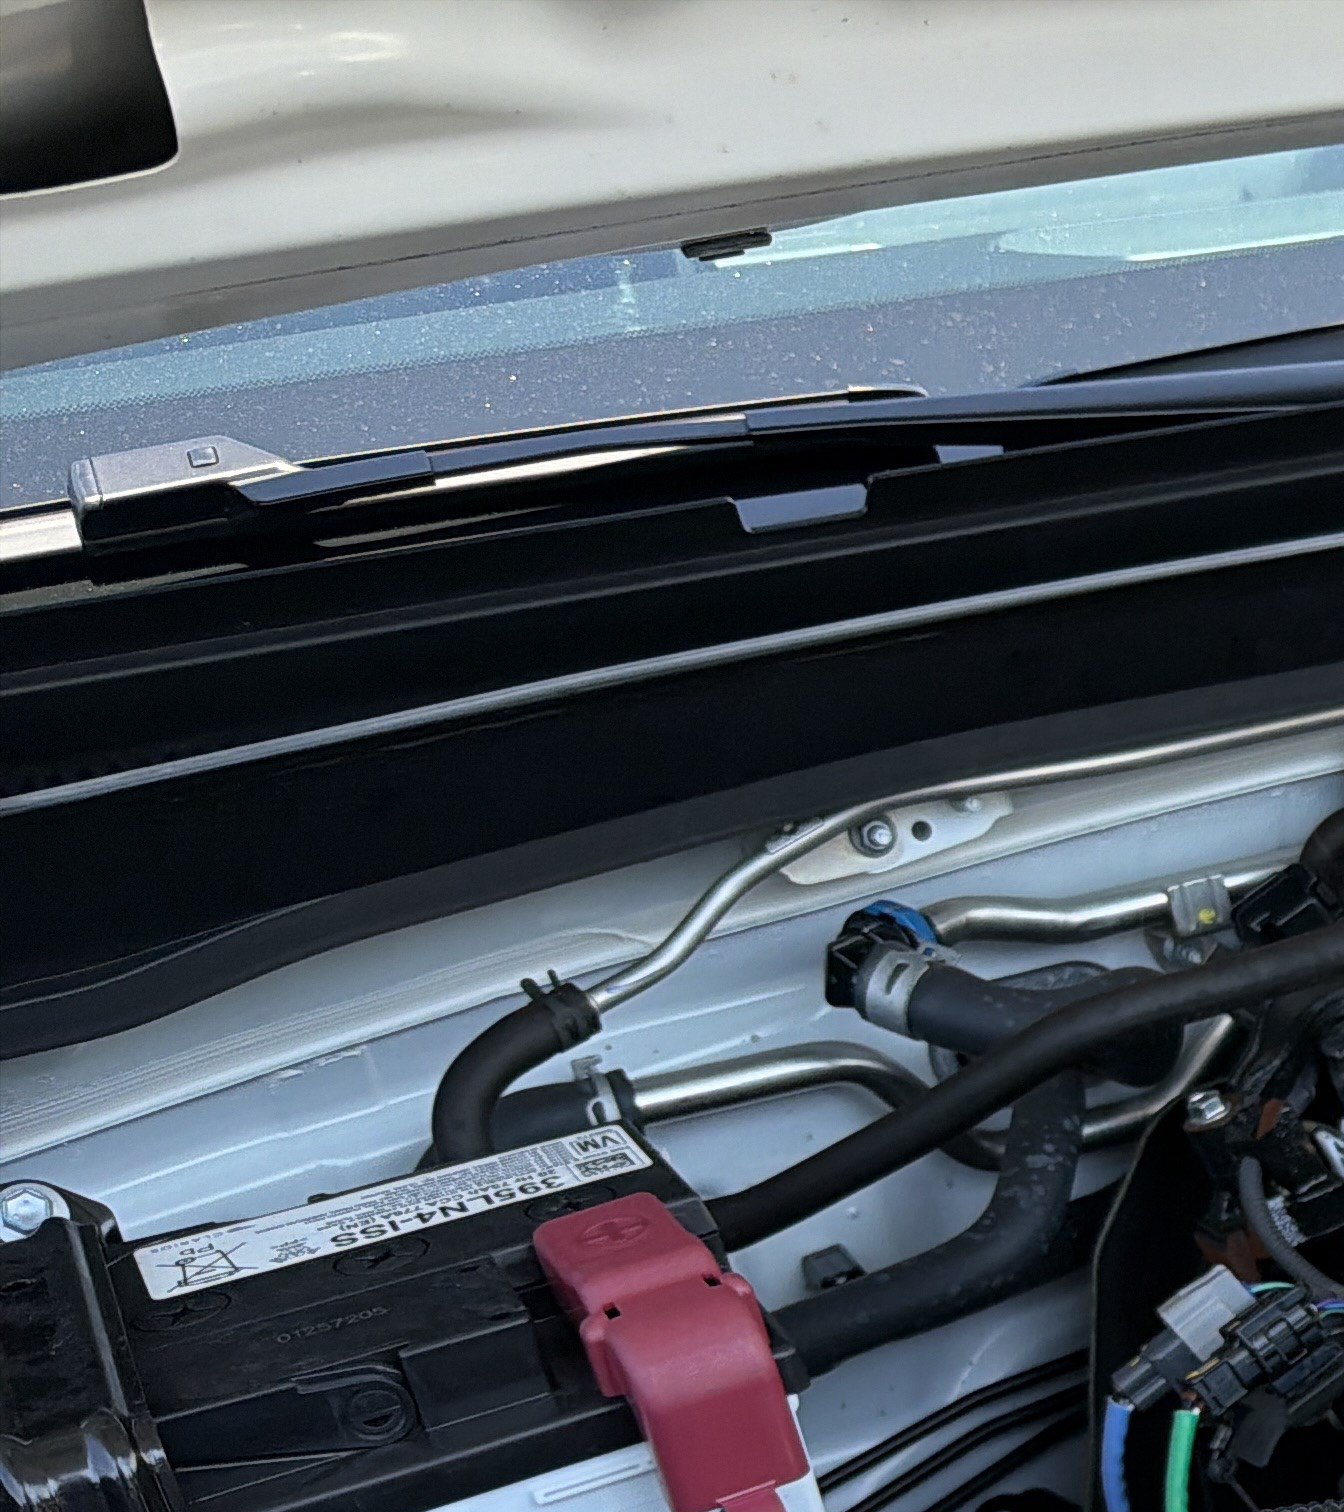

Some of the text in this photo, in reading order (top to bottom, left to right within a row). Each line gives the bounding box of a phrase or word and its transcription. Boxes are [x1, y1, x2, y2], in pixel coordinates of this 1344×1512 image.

[577, 1134, 620, 1153] VM
[330, 1175, 565, 1247] 395LN4-ISS
[179, 1243, 214, 1256] Pb
